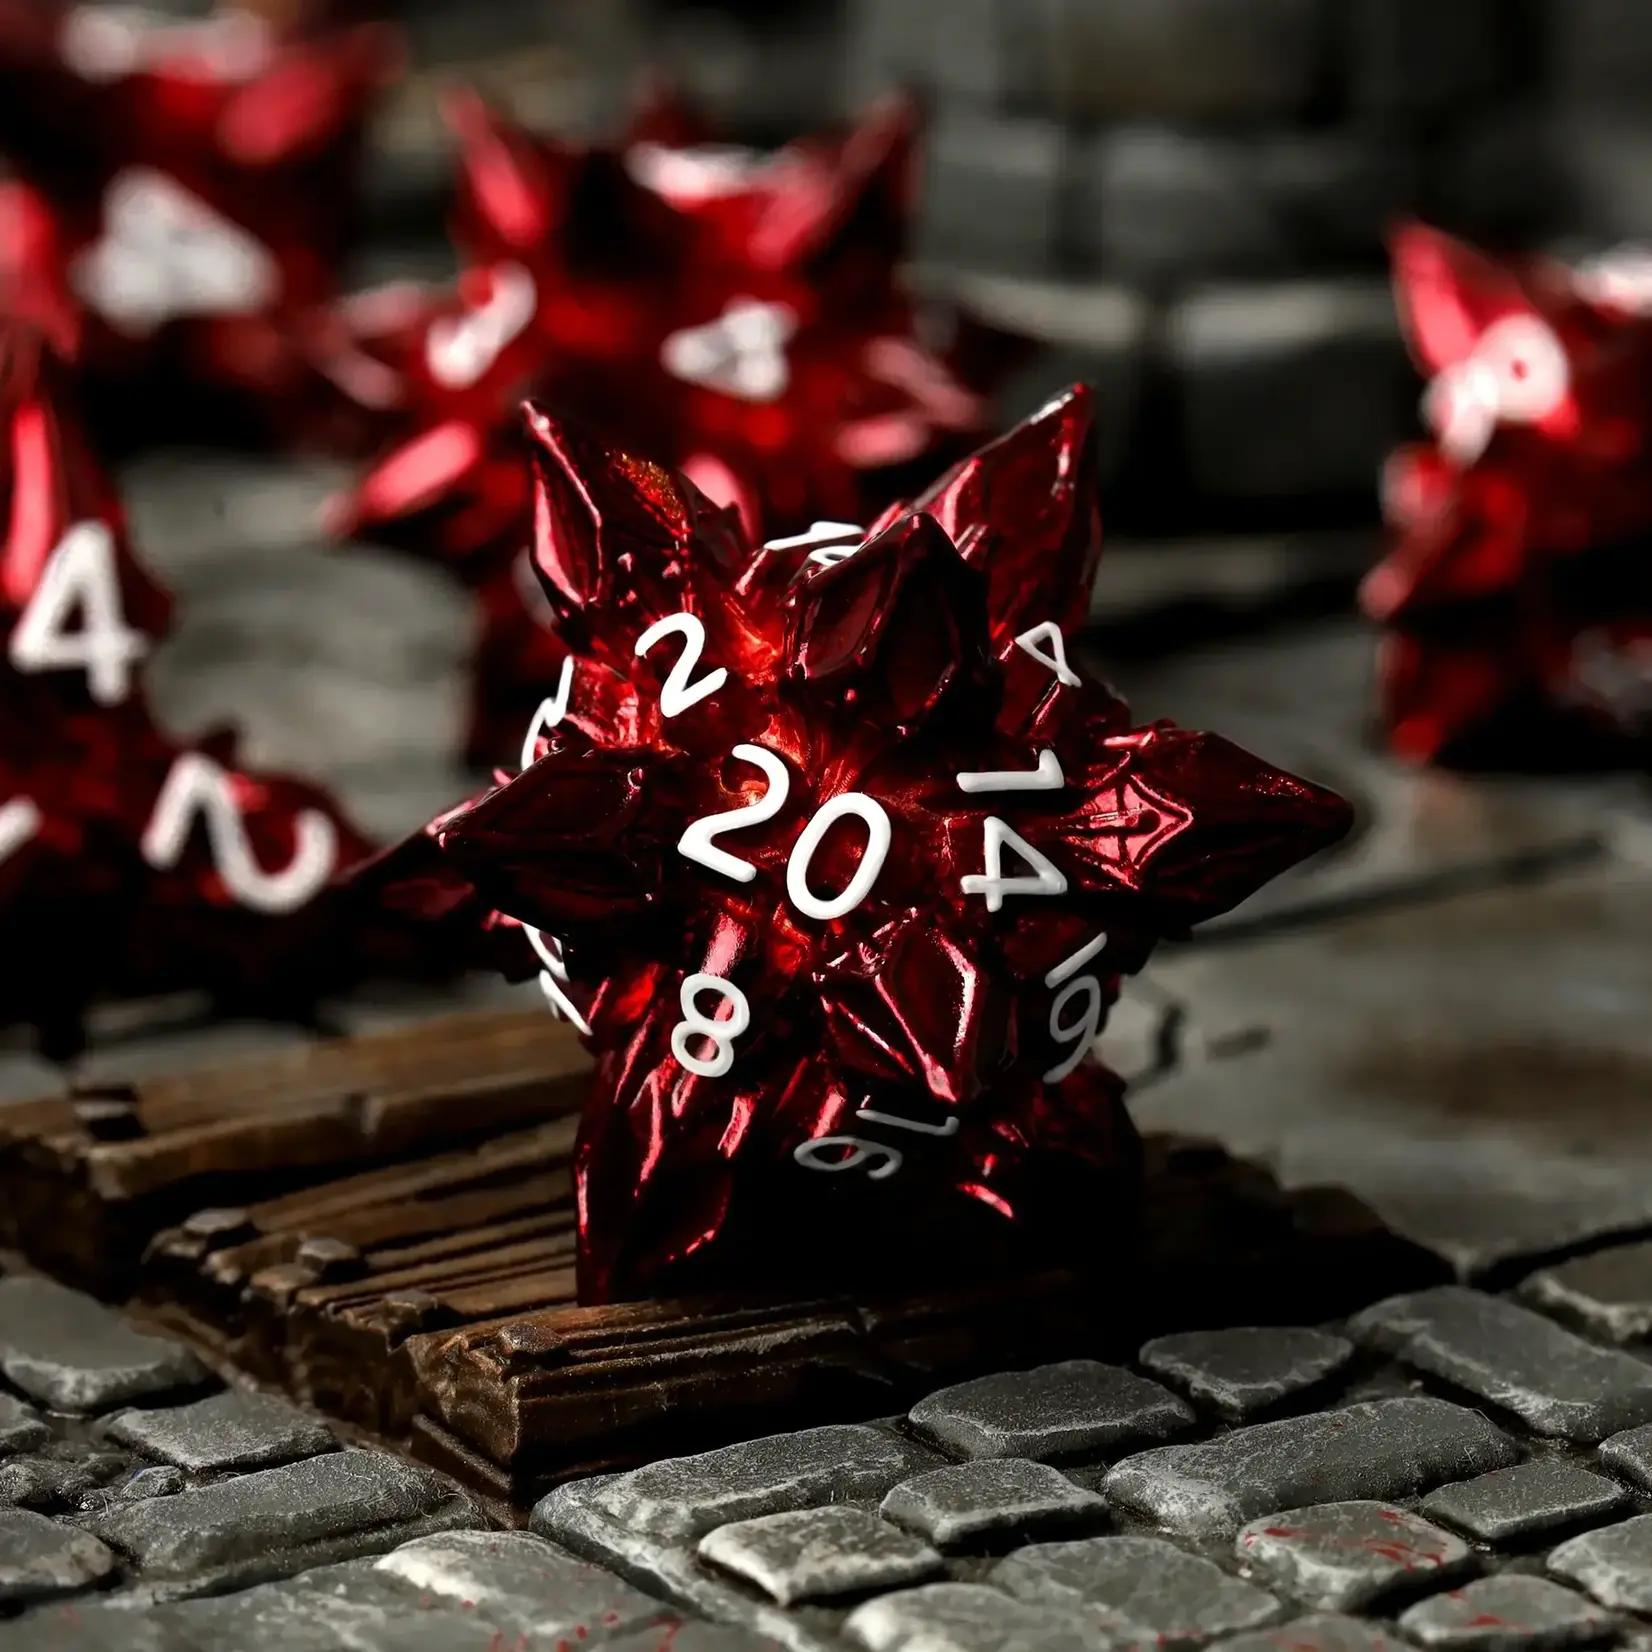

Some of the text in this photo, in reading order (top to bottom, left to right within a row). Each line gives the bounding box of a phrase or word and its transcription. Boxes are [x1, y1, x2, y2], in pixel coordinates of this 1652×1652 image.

[11, 521, 142, 703] 4
[635, 612, 727, 717] 2
[678, 744, 890, 919] 20
[957, 750, 1065, 912] 14
[671, 973, 749, 1077] 8
